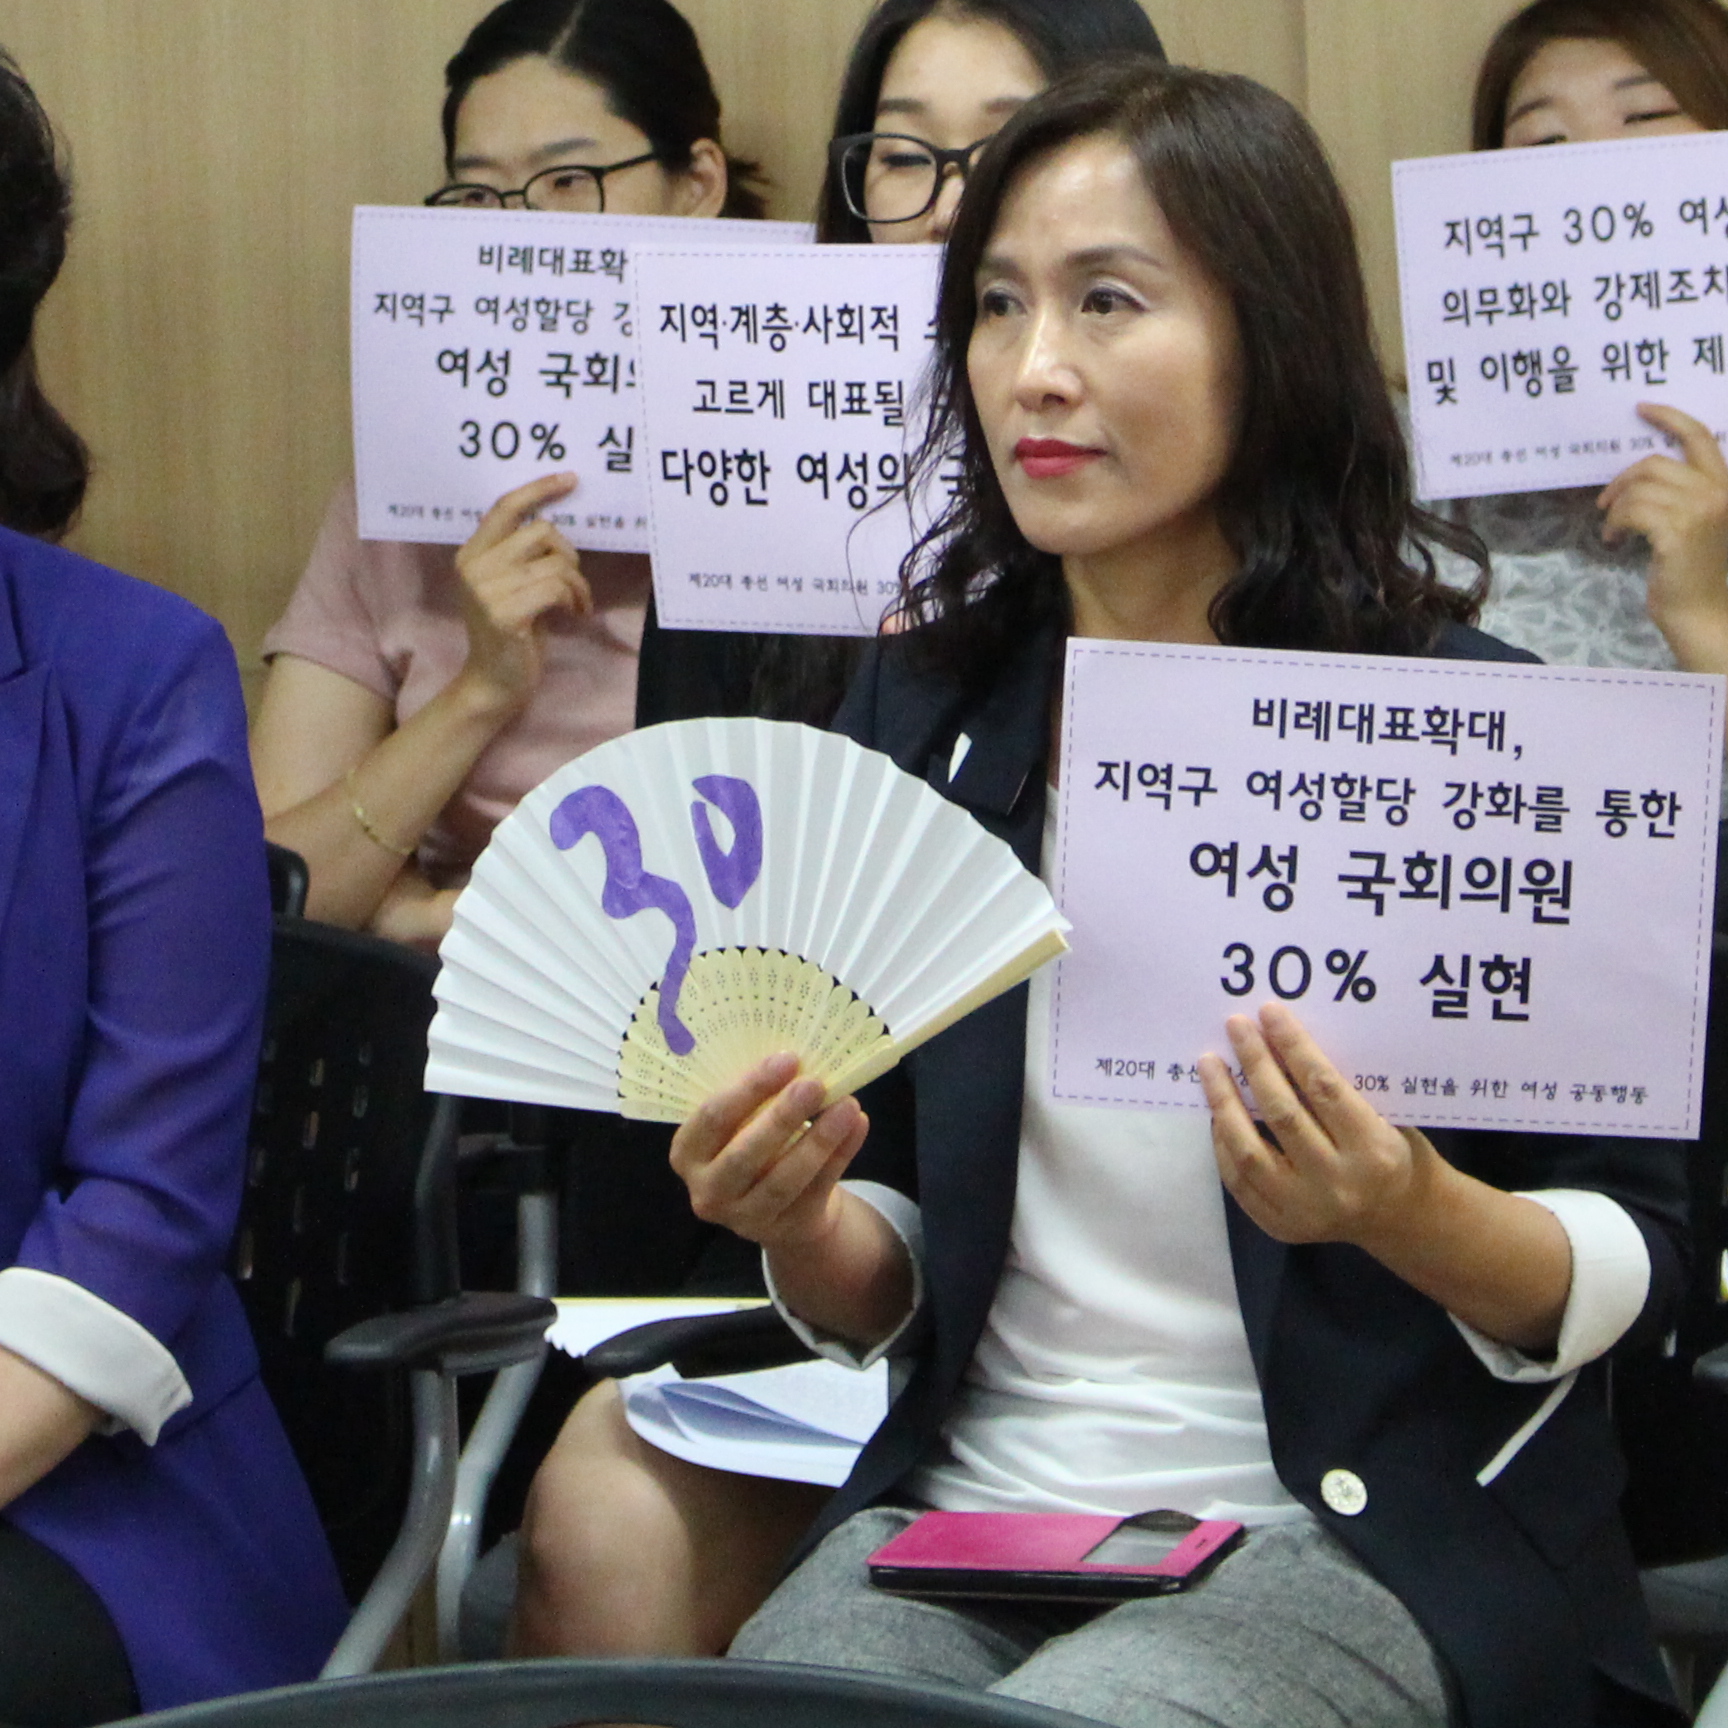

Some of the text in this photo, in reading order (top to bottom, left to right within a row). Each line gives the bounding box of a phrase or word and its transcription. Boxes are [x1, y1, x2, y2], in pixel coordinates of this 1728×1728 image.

[1445, 214, 1539, 258] 지역구
[1564, 203, 1653, 244] 30%
[479, 245, 628, 283] 비례대표확
[374, 293, 454, 326] 지역구
[475, 296, 593, 334] 여성할당
[1443, 280, 1571, 327] 의무화와
[437, 348, 510, 397] 여성
[1427, 358, 1456, 405] 및
[1480, 346, 1578, 398] 이행을
[1602, 339, 1668, 385] 위한
[693, 380, 906, 430] 고르게 대표될
[460, 420, 633, 472] 30% 실
[662, 449, 770, 506] 다양한
[796, 452, 910, 510] 여성의
[1253, 699, 1522, 760] 비례대표확대,
[1095, 761, 1681, 838] 지역구 여성할당 강화를 통한
[1190, 842, 1572, 925] 여성 국회의원
[1221, 943, 1531, 1021] 30% 실현
[1095, 1058, 1155, 1080] 제20대
[1354, 1074, 1389, 1093] 30%
[1470, 1078, 1508, 1099] 위한
[1521, 1080, 1557, 1102] 여성
